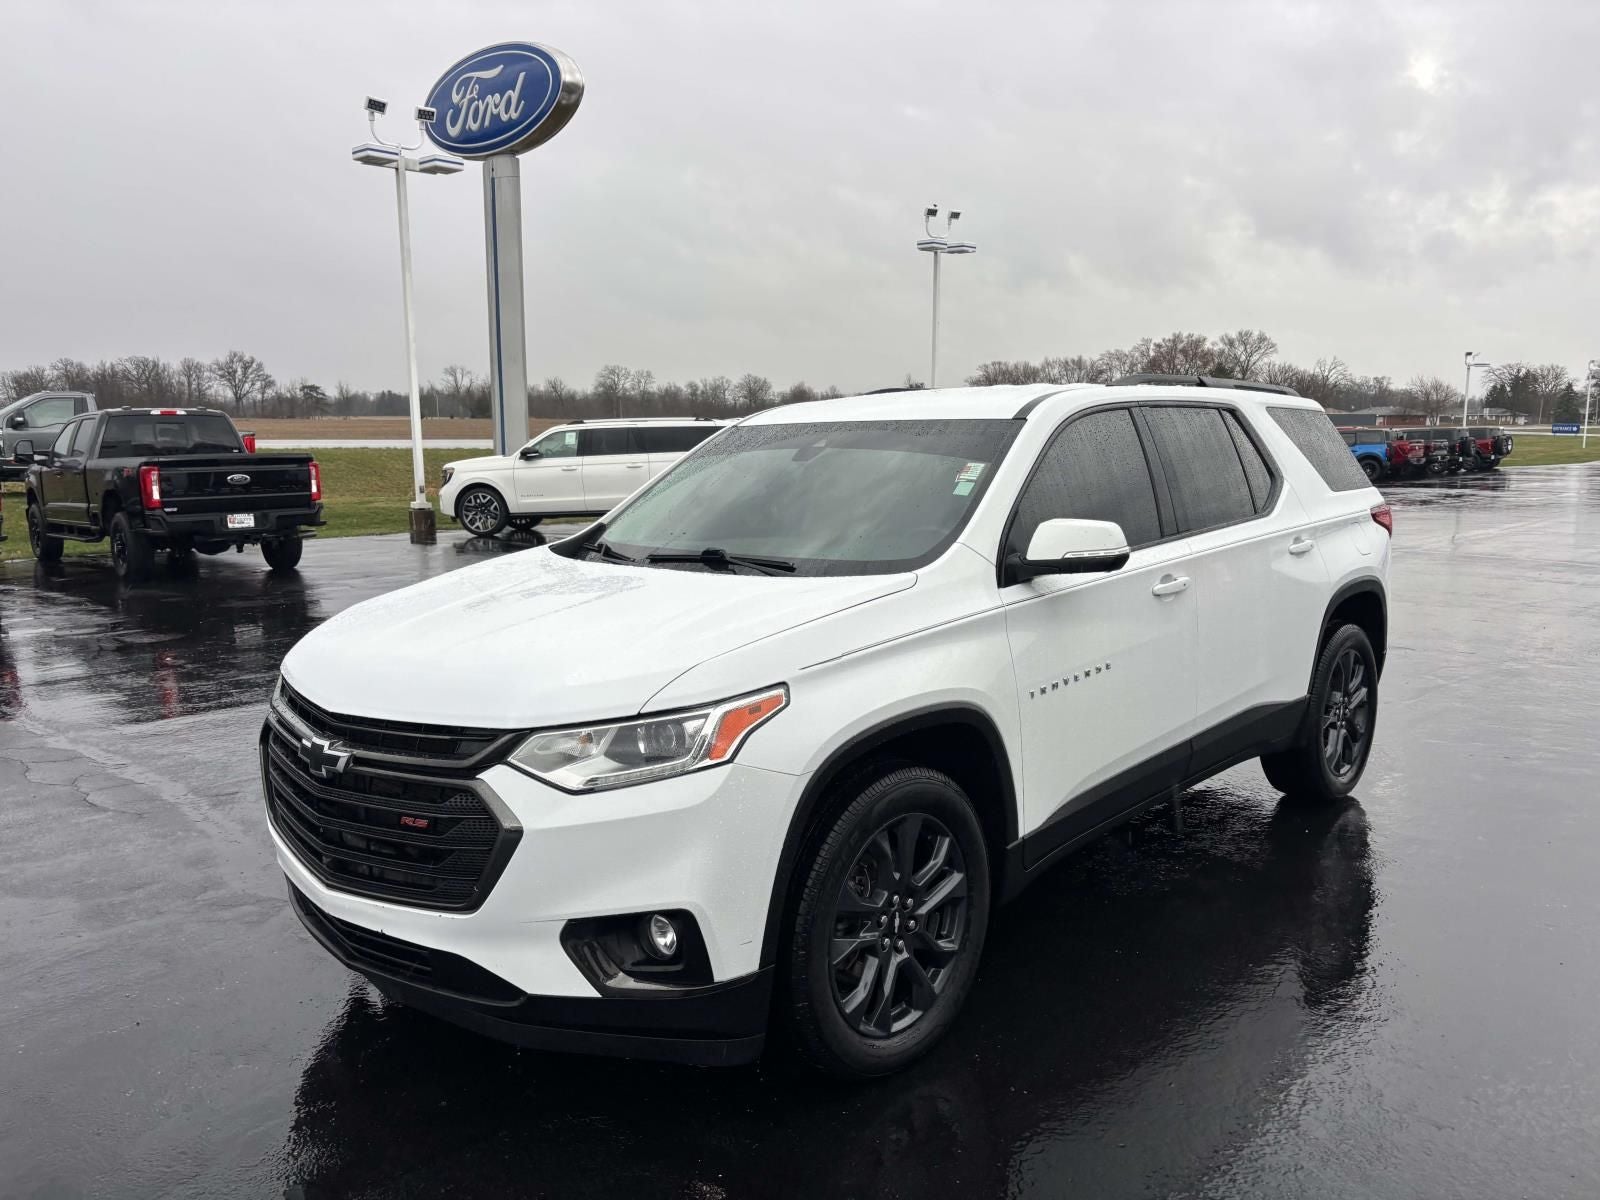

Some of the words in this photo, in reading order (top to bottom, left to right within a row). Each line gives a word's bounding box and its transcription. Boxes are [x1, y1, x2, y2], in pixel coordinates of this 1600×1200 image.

[446, 64, 526, 138] Ford
[1029, 662, 1111, 699] TRAVERSE
[400, 816, 428, 828] RS
